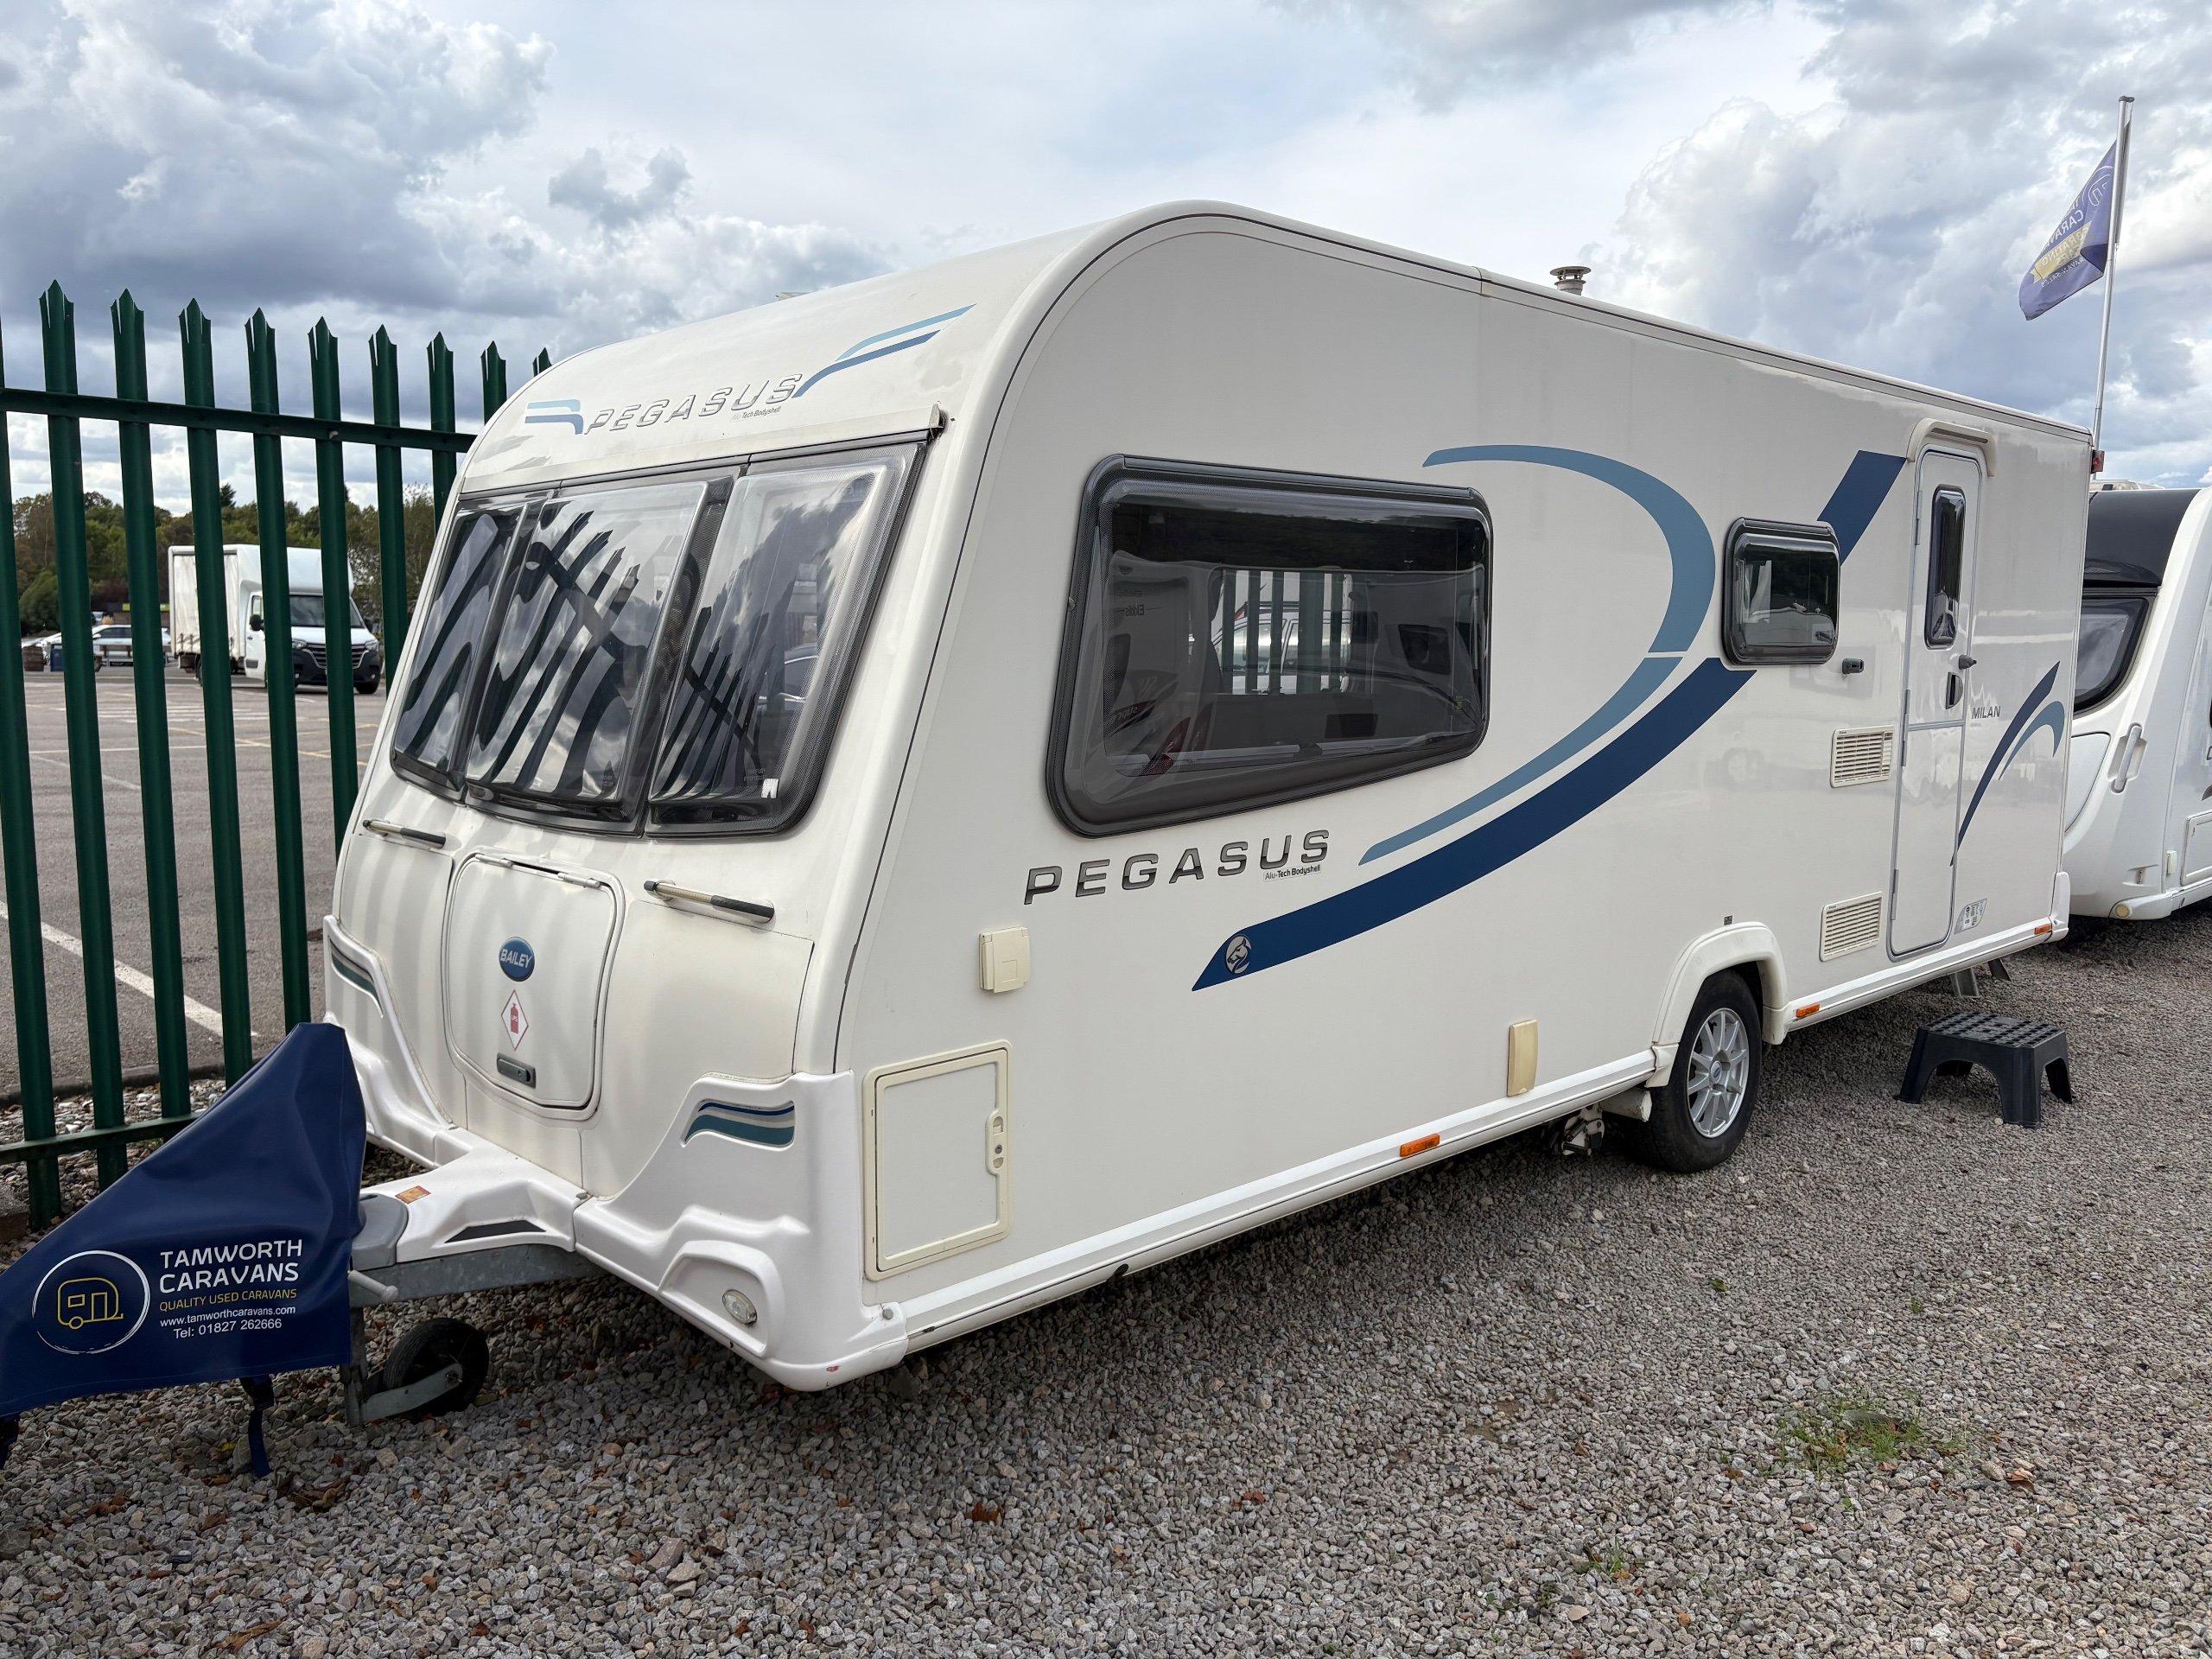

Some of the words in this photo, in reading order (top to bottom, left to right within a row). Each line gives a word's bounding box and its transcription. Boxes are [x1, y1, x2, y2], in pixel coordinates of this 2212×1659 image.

[584, 373, 803, 435] PEGASUS
[1971, 705, 2001, 720] MILAN
[1024, 830, 1330, 906] PEGASUS
[1264, 869, 1291, 880] Alu-Tech
[1292, 864, 1321, 875] Bodyshell
[500, 948, 532, 969] BAILEY
[160, 1238, 302, 1269] TAMWORTH
[159, 1262, 299, 1294] CARAVANS
[159, 1296, 207, 1312] QUALITY
[209, 1292, 239, 1305] USED
[241, 1288, 297, 1300] CARAVANS
[160, 1306, 296, 1327] www.tamworthcaravans.com
[173, 1326, 195, 1339] Tel:
[198, 1320, 237, 1335] 01827
[240, 1319, 283, 1331] 262666
